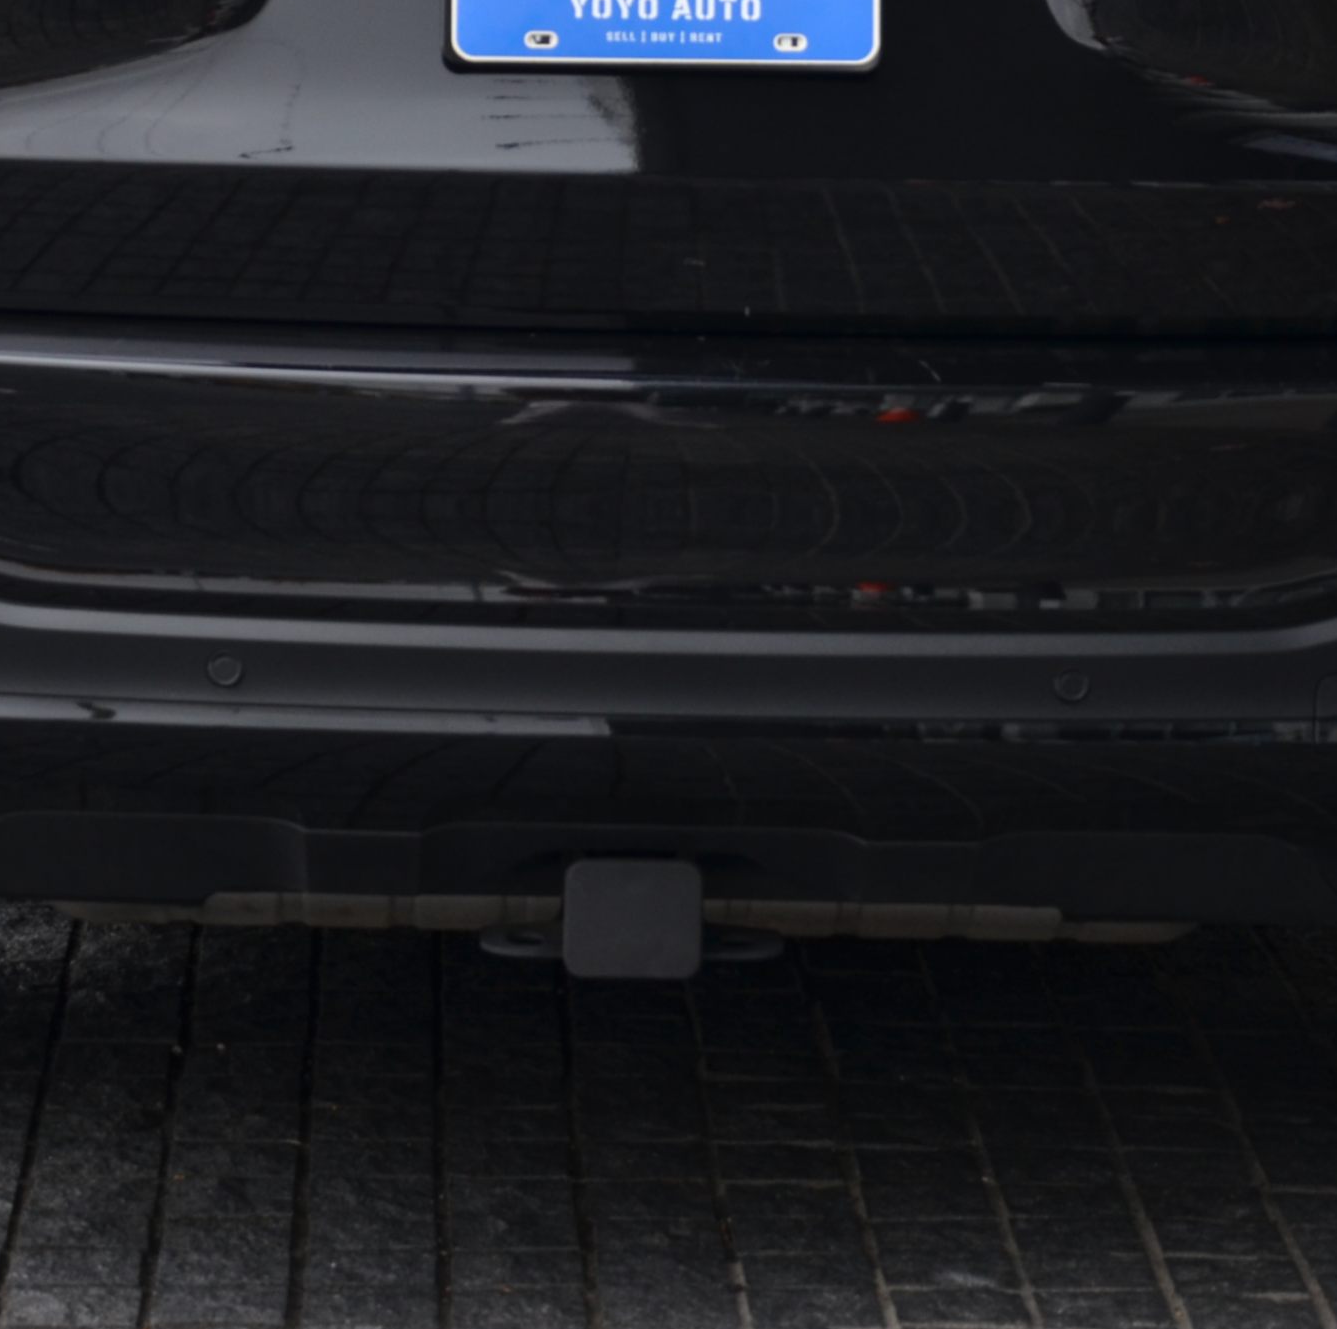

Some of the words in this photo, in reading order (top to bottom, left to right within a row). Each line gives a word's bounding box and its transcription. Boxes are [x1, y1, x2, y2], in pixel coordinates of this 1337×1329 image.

[605, 30, 636, 43] SELL
[650, 31, 676, 43] BUY
[689, 31, 723, 44] RENT
